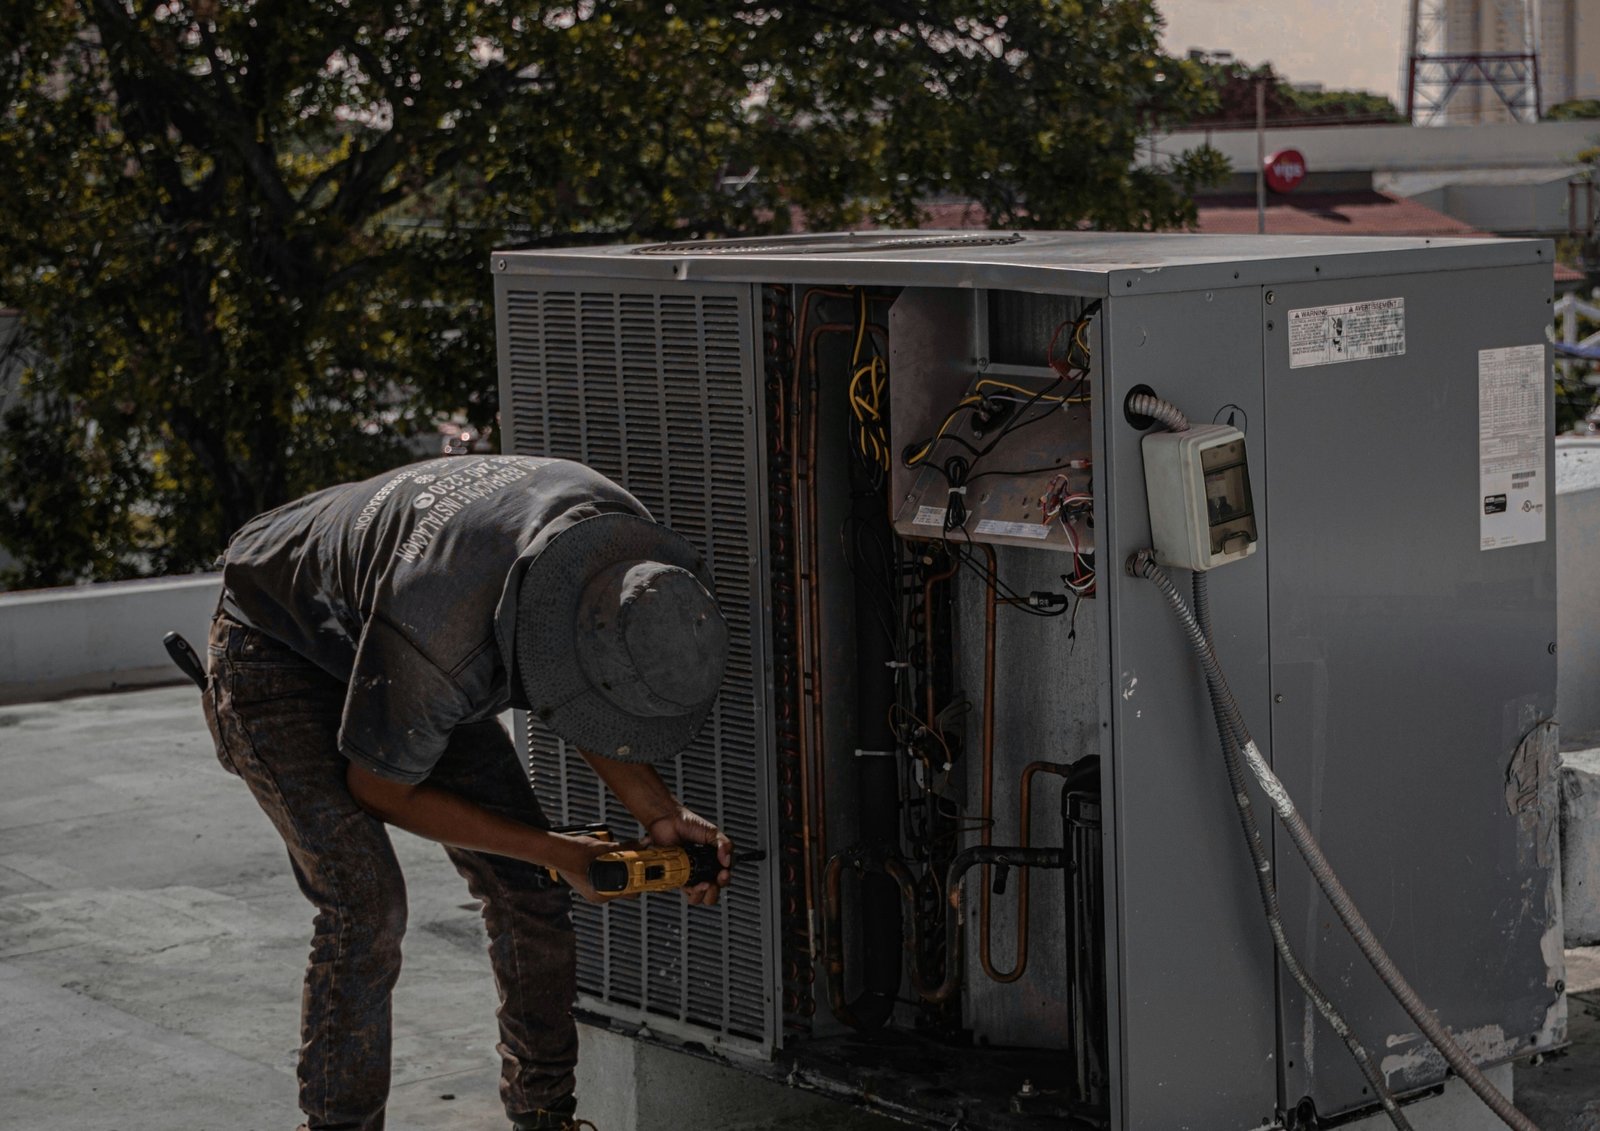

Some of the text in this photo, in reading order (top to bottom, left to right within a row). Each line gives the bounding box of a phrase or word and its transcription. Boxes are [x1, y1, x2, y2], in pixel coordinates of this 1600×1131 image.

[1300, 308, 1328, 318] WARNING
[1354, 300, 1397, 312] AVERTISSEMENT
[463, 462, 499, 478] 240
[428, 469, 472, 495] 3230
[396, 496, 465, 563] INSTALACIÓN
